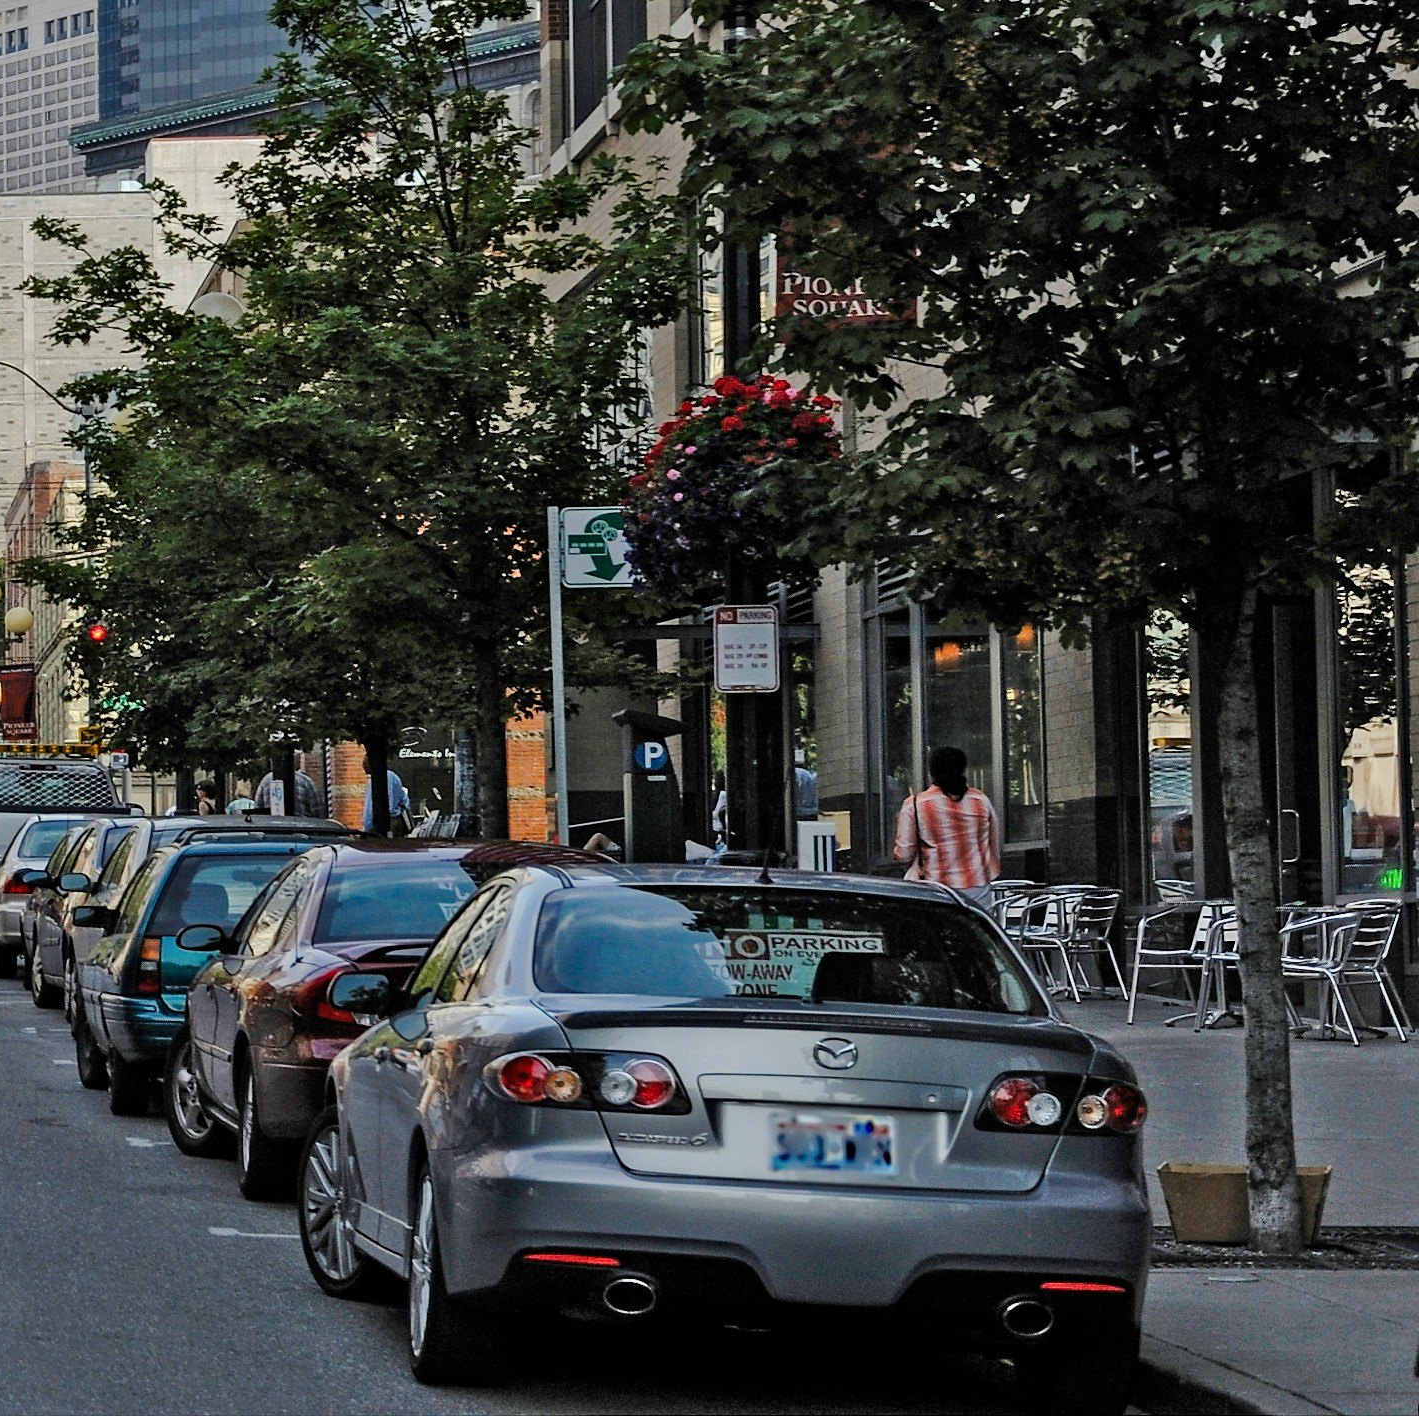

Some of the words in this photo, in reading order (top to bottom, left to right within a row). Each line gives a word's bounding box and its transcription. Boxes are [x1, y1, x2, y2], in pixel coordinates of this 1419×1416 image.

[719, 611, 734, 621] NO
[739, 611, 772, 620] PARKING
[644, 741, 664, 769] P
[771, 936, 878, 951] PARKING
[773, 949, 793, 957] ON
